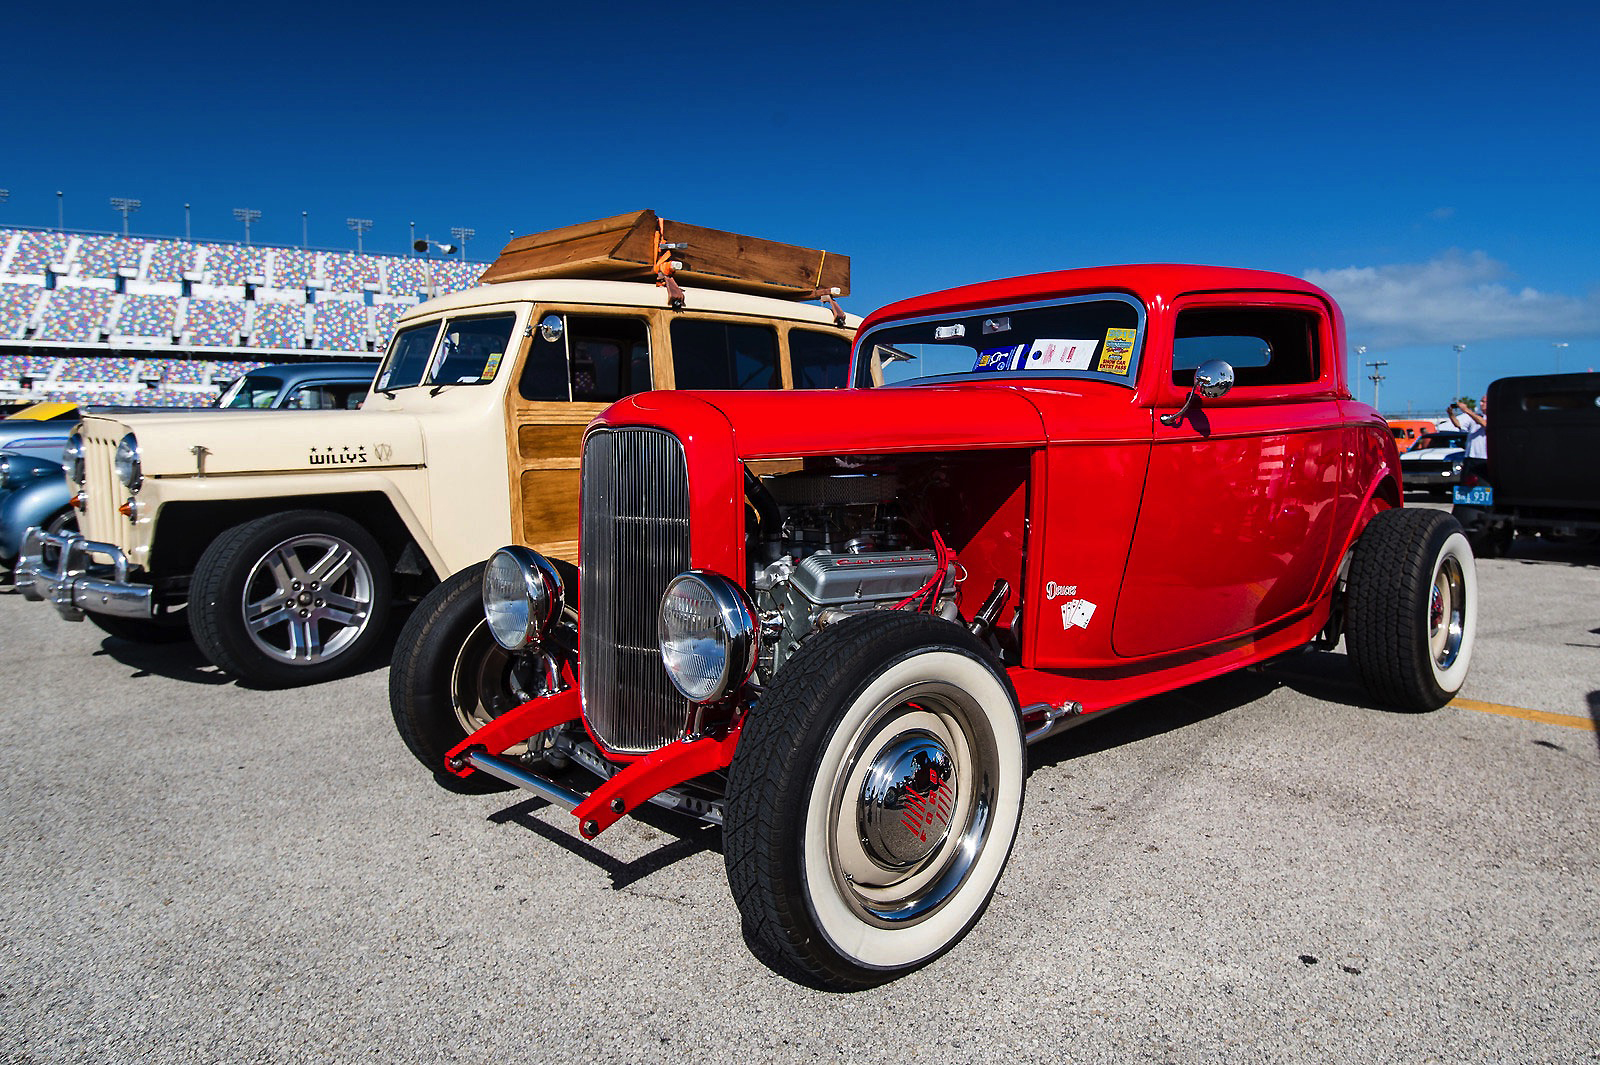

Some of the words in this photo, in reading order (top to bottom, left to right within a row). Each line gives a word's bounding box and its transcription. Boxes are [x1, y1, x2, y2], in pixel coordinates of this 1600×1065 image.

[309, 453, 367, 464] WILLYS
[1473, 491, 1490, 502] 937
[919, 768, 938, 842] FORD
